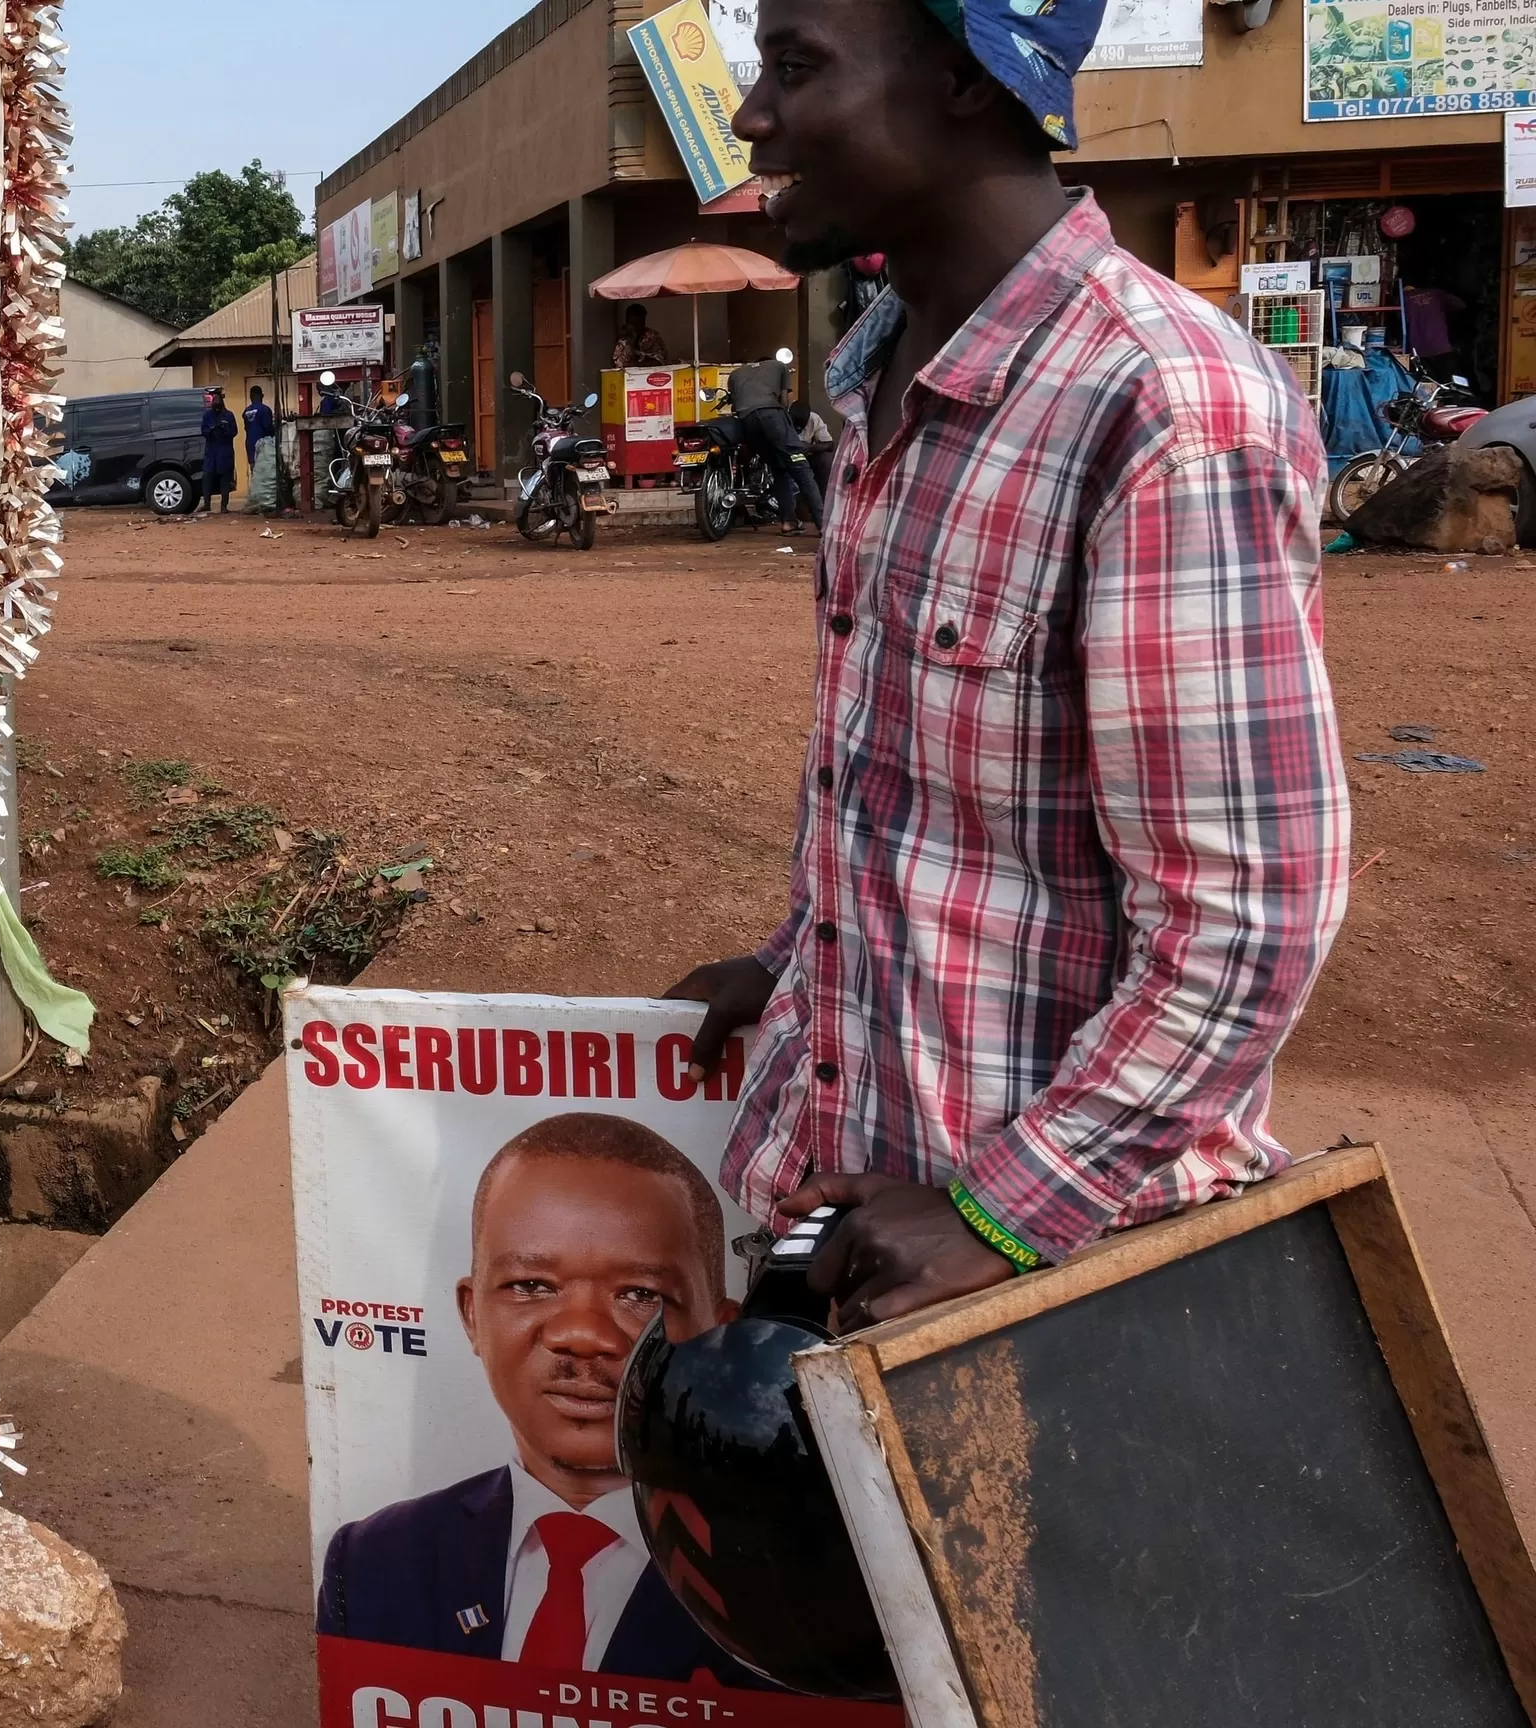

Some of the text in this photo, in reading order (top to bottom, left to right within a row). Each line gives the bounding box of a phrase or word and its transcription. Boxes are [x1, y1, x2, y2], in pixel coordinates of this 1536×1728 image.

[1388, 3, 1424, 17] Dealers
[1427, 2, 1440, 14] in:
[1442, 1, 1473, 15] Plugs,
[1476, 0, 1520, 12] Fanbelts,
[1448, 18, 1471, 28] Side
[1473, 16, 1506, 28] mirror,
[1100, 46, 1125, 61] 490
[1145, 43, 1189, 53] Located:
[640, 28, 717, 192] MOTORCYCLE SPARE GARAGE CENTRE
[718, 87, 737, 118] Shel
[1334, 101, 1370, 117] Tel:
[1378, 93, 1472, 115] 0771-896
[697, 82, 747, 165] ADVANCE
[301, 1020, 637, 1099] SSERUBIRI
[321, 1298, 424, 1323] PROTEST
[313, 1318, 427, 1357] VOTE
